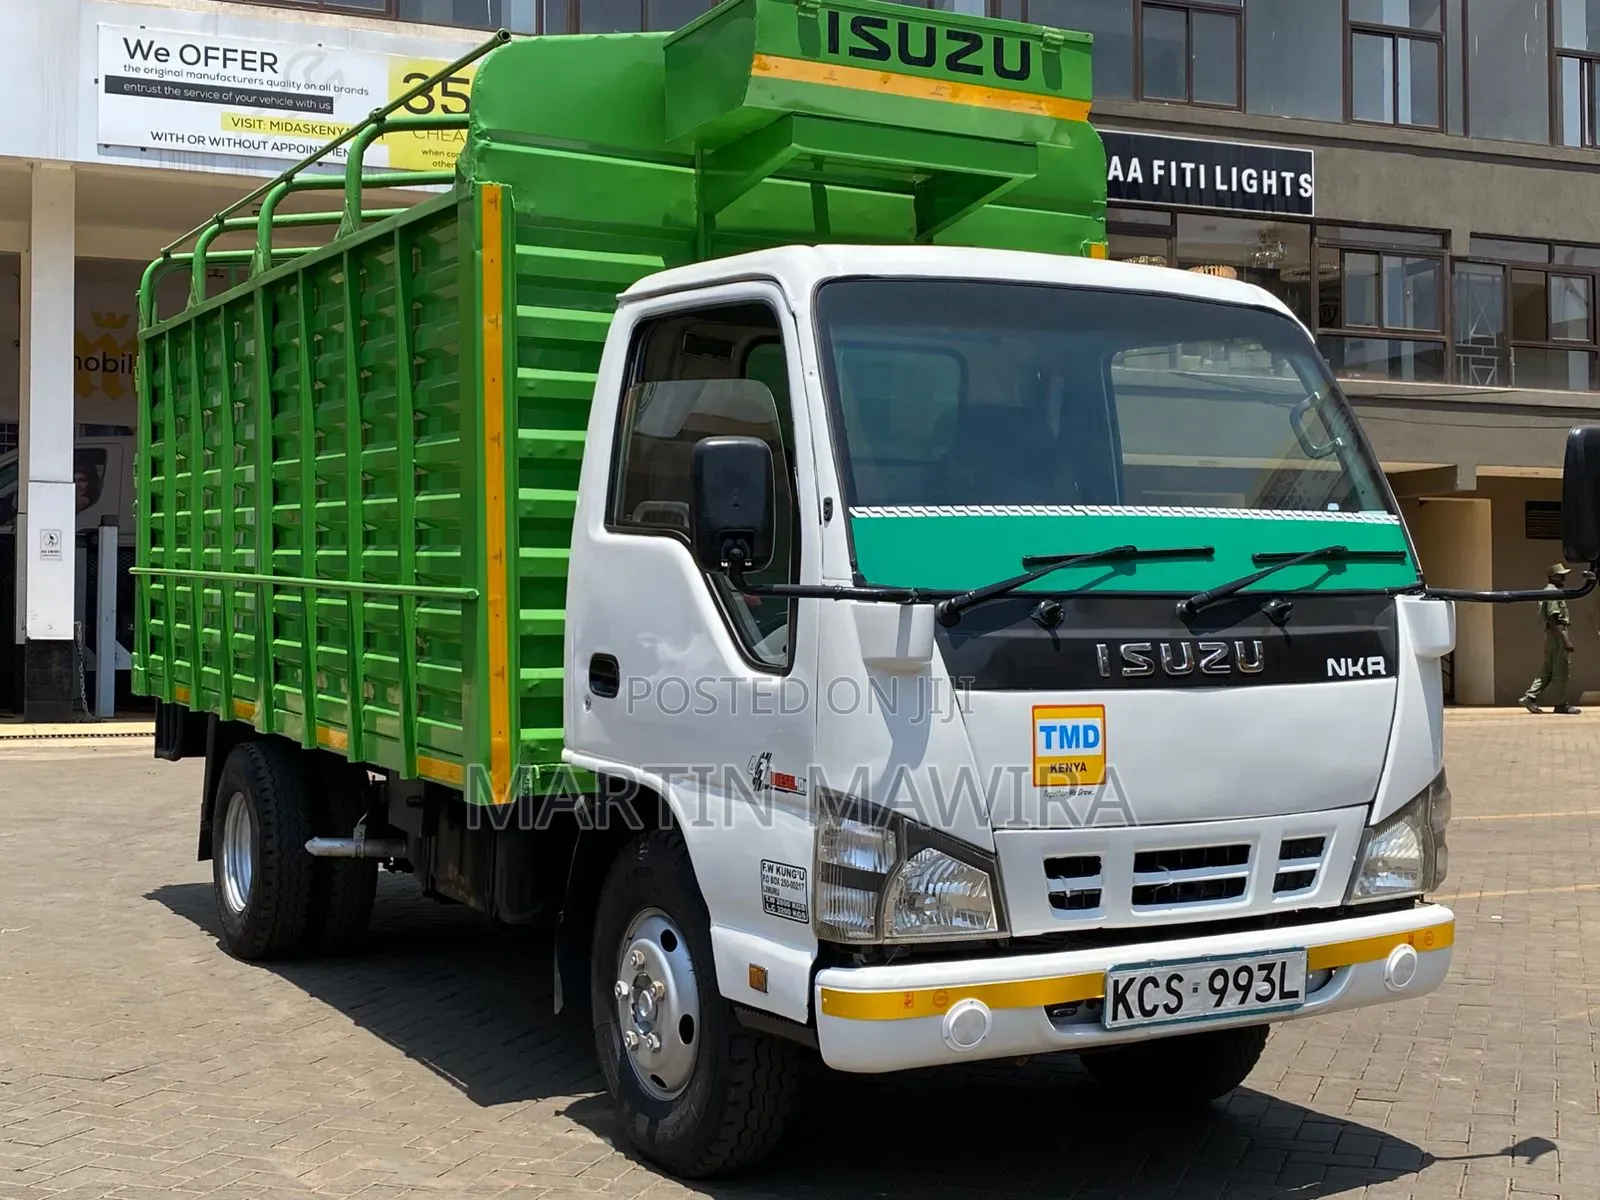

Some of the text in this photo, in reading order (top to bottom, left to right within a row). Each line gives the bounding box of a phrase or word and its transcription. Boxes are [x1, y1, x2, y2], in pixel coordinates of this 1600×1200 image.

[122, 36, 279, 74] We OFFER
[828, 10, 1031, 81] ISUZU
[123, 64, 370, 96] the original manufacturers quality on all brands
[123, 81, 332, 111] entrust the service of your vehicle with us
[231, 116, 267, 130] VISIT:
[150, 131, 185, 144] WITH
[187, 133, 206, 146] OR
[208, 136, 269, 151] WITHOUT
[421, 148, 446, 156] when
[1152, 159, 1206, 190] FITI
[1214, 164, 1314, 198] LIGHTS
[1095, 639, 1265, 677] ISUZU
[1326, 655, 1387, 678] NKR
[1039, 724, 1101, 750] TMD
[1049, 762, 1088, 774] KENYA
[1111, 961, 1300, 1022] KCS 993L
